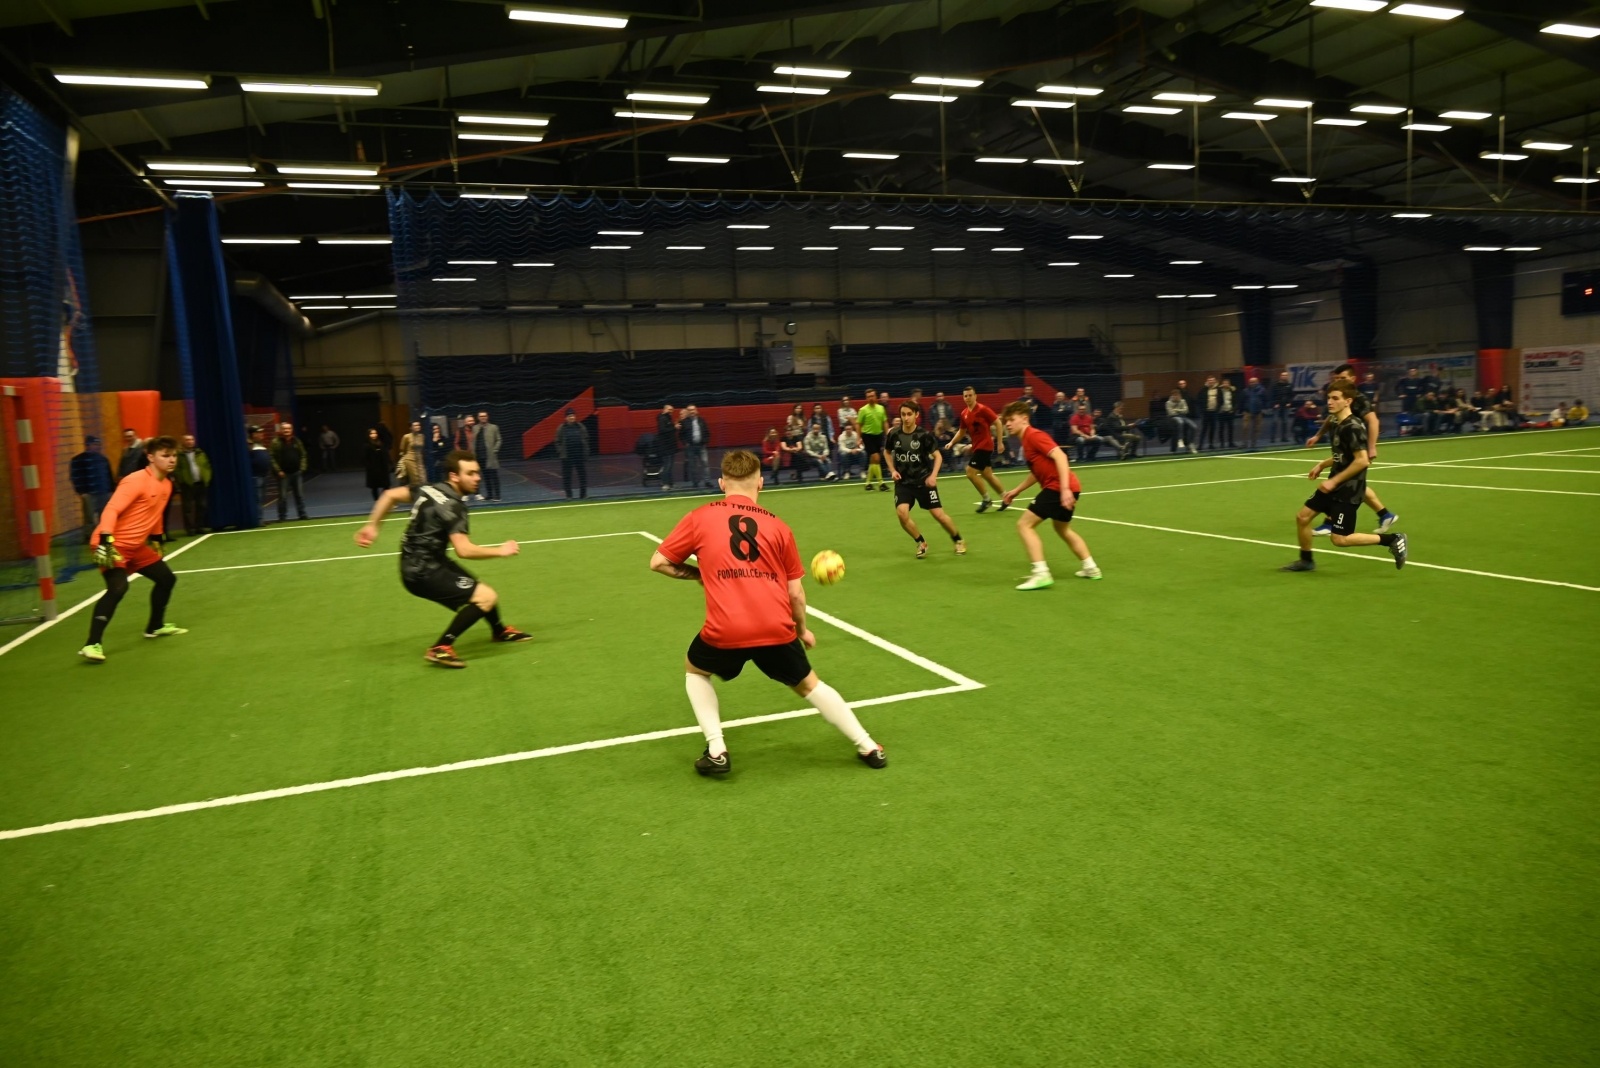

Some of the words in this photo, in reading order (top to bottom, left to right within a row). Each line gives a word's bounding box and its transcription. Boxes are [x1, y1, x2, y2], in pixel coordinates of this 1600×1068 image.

[929, 490, 938, 500] 20
[1337, 512, 1345, 525] 9
[729, 515, 760, 562] 8
